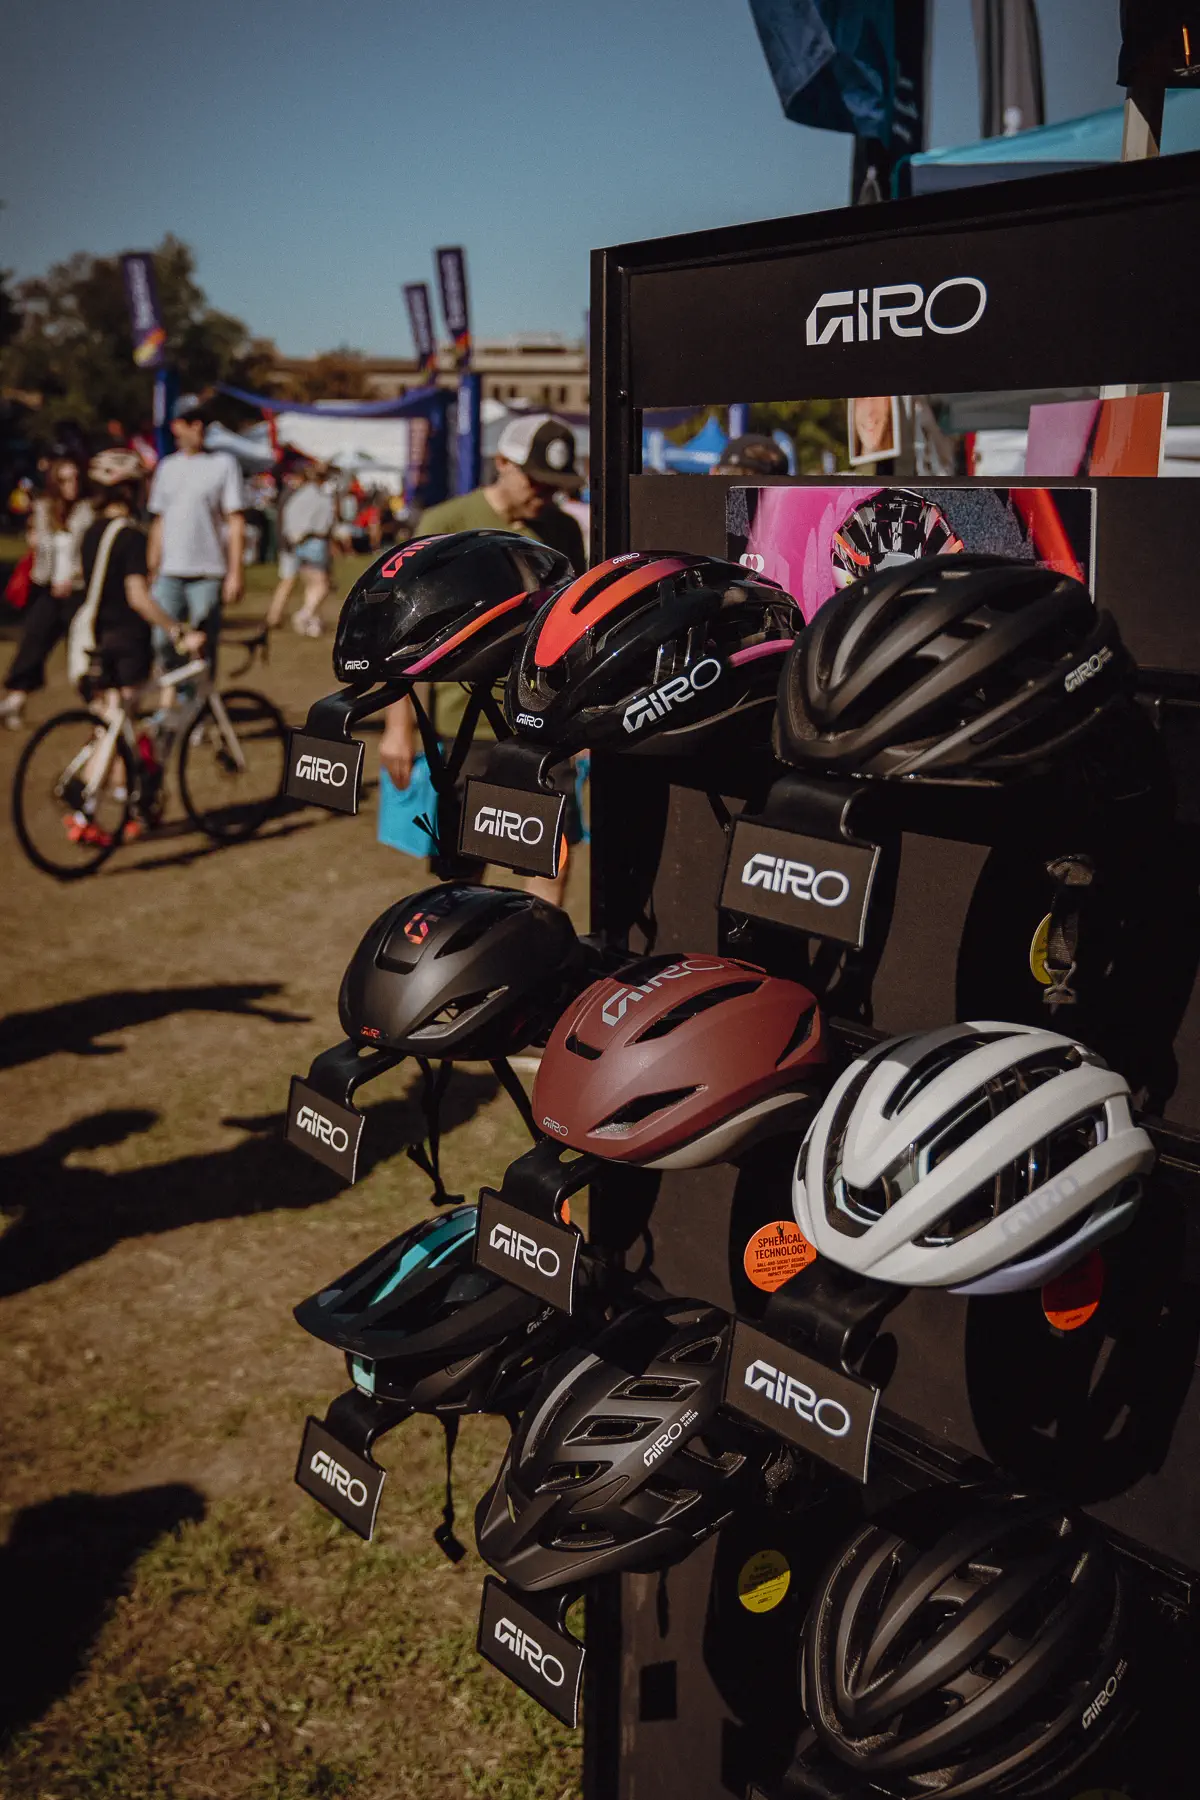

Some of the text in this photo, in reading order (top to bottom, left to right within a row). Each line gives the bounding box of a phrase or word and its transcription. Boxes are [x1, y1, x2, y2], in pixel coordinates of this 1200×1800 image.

[804, 276, 987, 346] GIRO
[344, 659, 370, 671] GIRO
[1063, 652, 1103, 693] GIRO
[622, 657, 722, 734] GIRO
[515, 712, 544, 729] GIRO
[295, 754, 348, 787] GIRO
[474, 806, 544, 846] GIRO
[741, 852, 850, 907] GIRO
[296, 1105, 349, 1153] GIRO
[542, 1116, 569, 1137] GIRO
[489, 1222, 561, 1278] GIRO
[754, 1244, 807, 1260] TECHNOLOGY
[757, 1233, 803, 1248] SPHERICAL
[744, 1358, 851, 1438] GIRO
[643, 1422, 682, 1467] GIRO
[309, 1450, 368, 1507] GIRO
[494, 1617, 565, 1687] GIRO
[1081, 1675, 1117, 1730] GIRO
